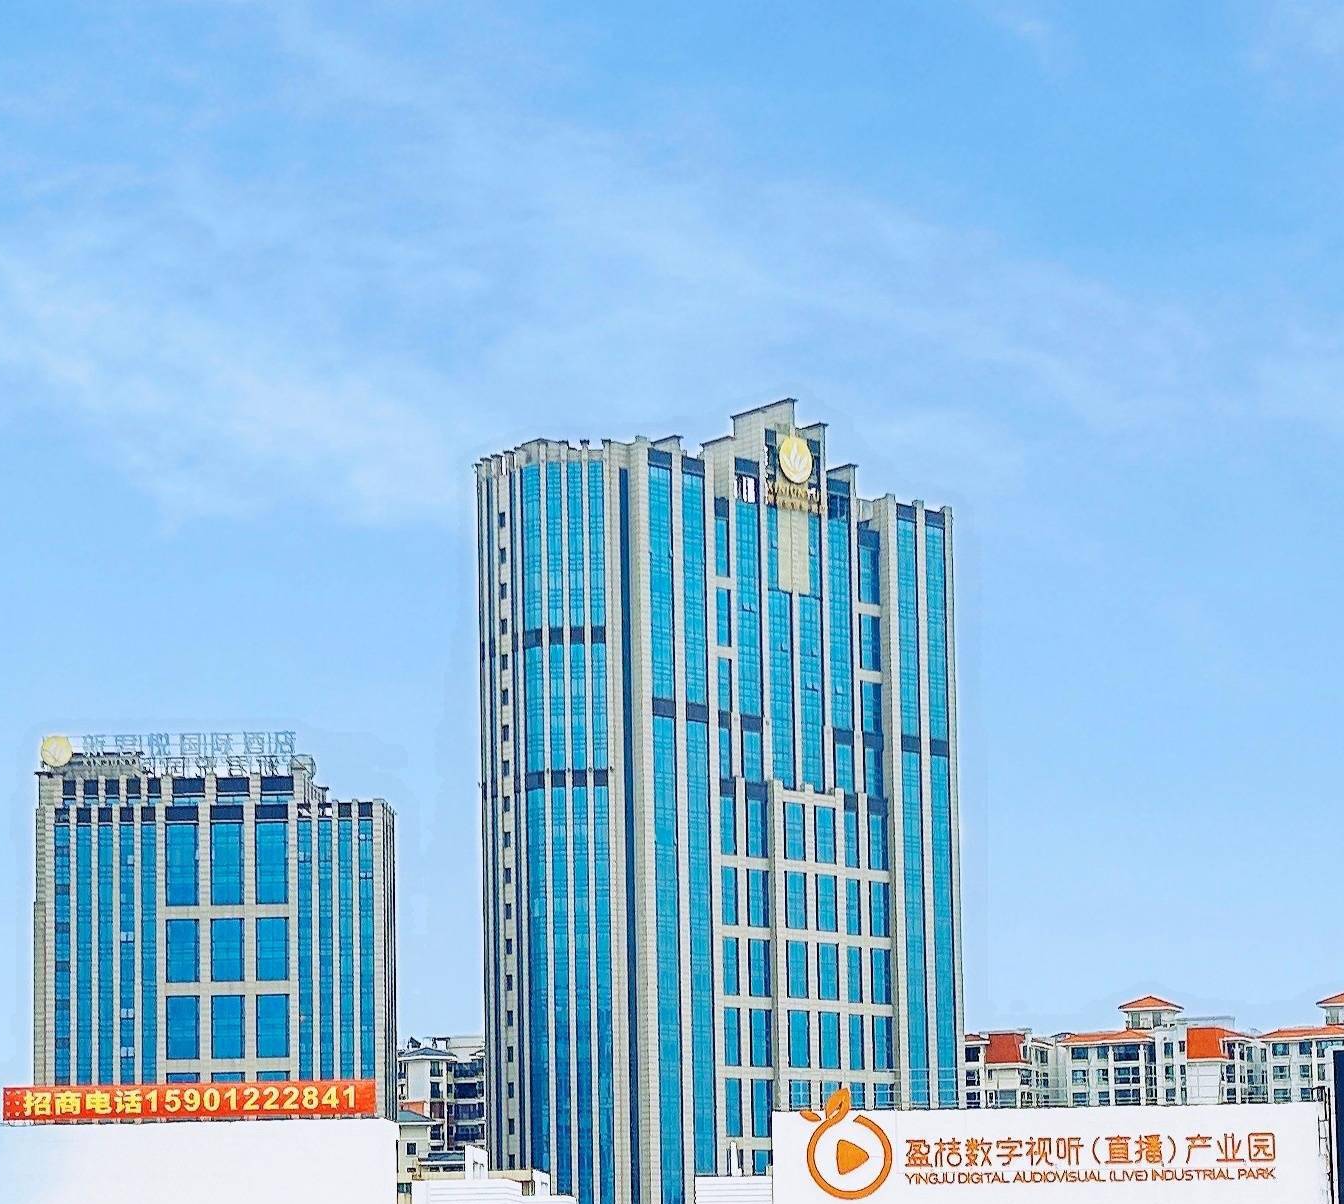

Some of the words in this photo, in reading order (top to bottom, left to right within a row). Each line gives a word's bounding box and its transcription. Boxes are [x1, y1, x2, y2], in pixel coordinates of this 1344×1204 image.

[24, 1087, 356, 1115] 招商电话15901222841
[905, 1172, 956, 1185] YINGJU
[958, 1172, 1010, 1184] DIGITAL
[1013, 1171, 1107, 1184] AUDIOVISUAL
[1109, 1170, 1149, 1183] (LIVE)
[1152, 1168, 1234, 1182] INDUSTRIAL
[1238, 1167, 1276, 1180] PARK
